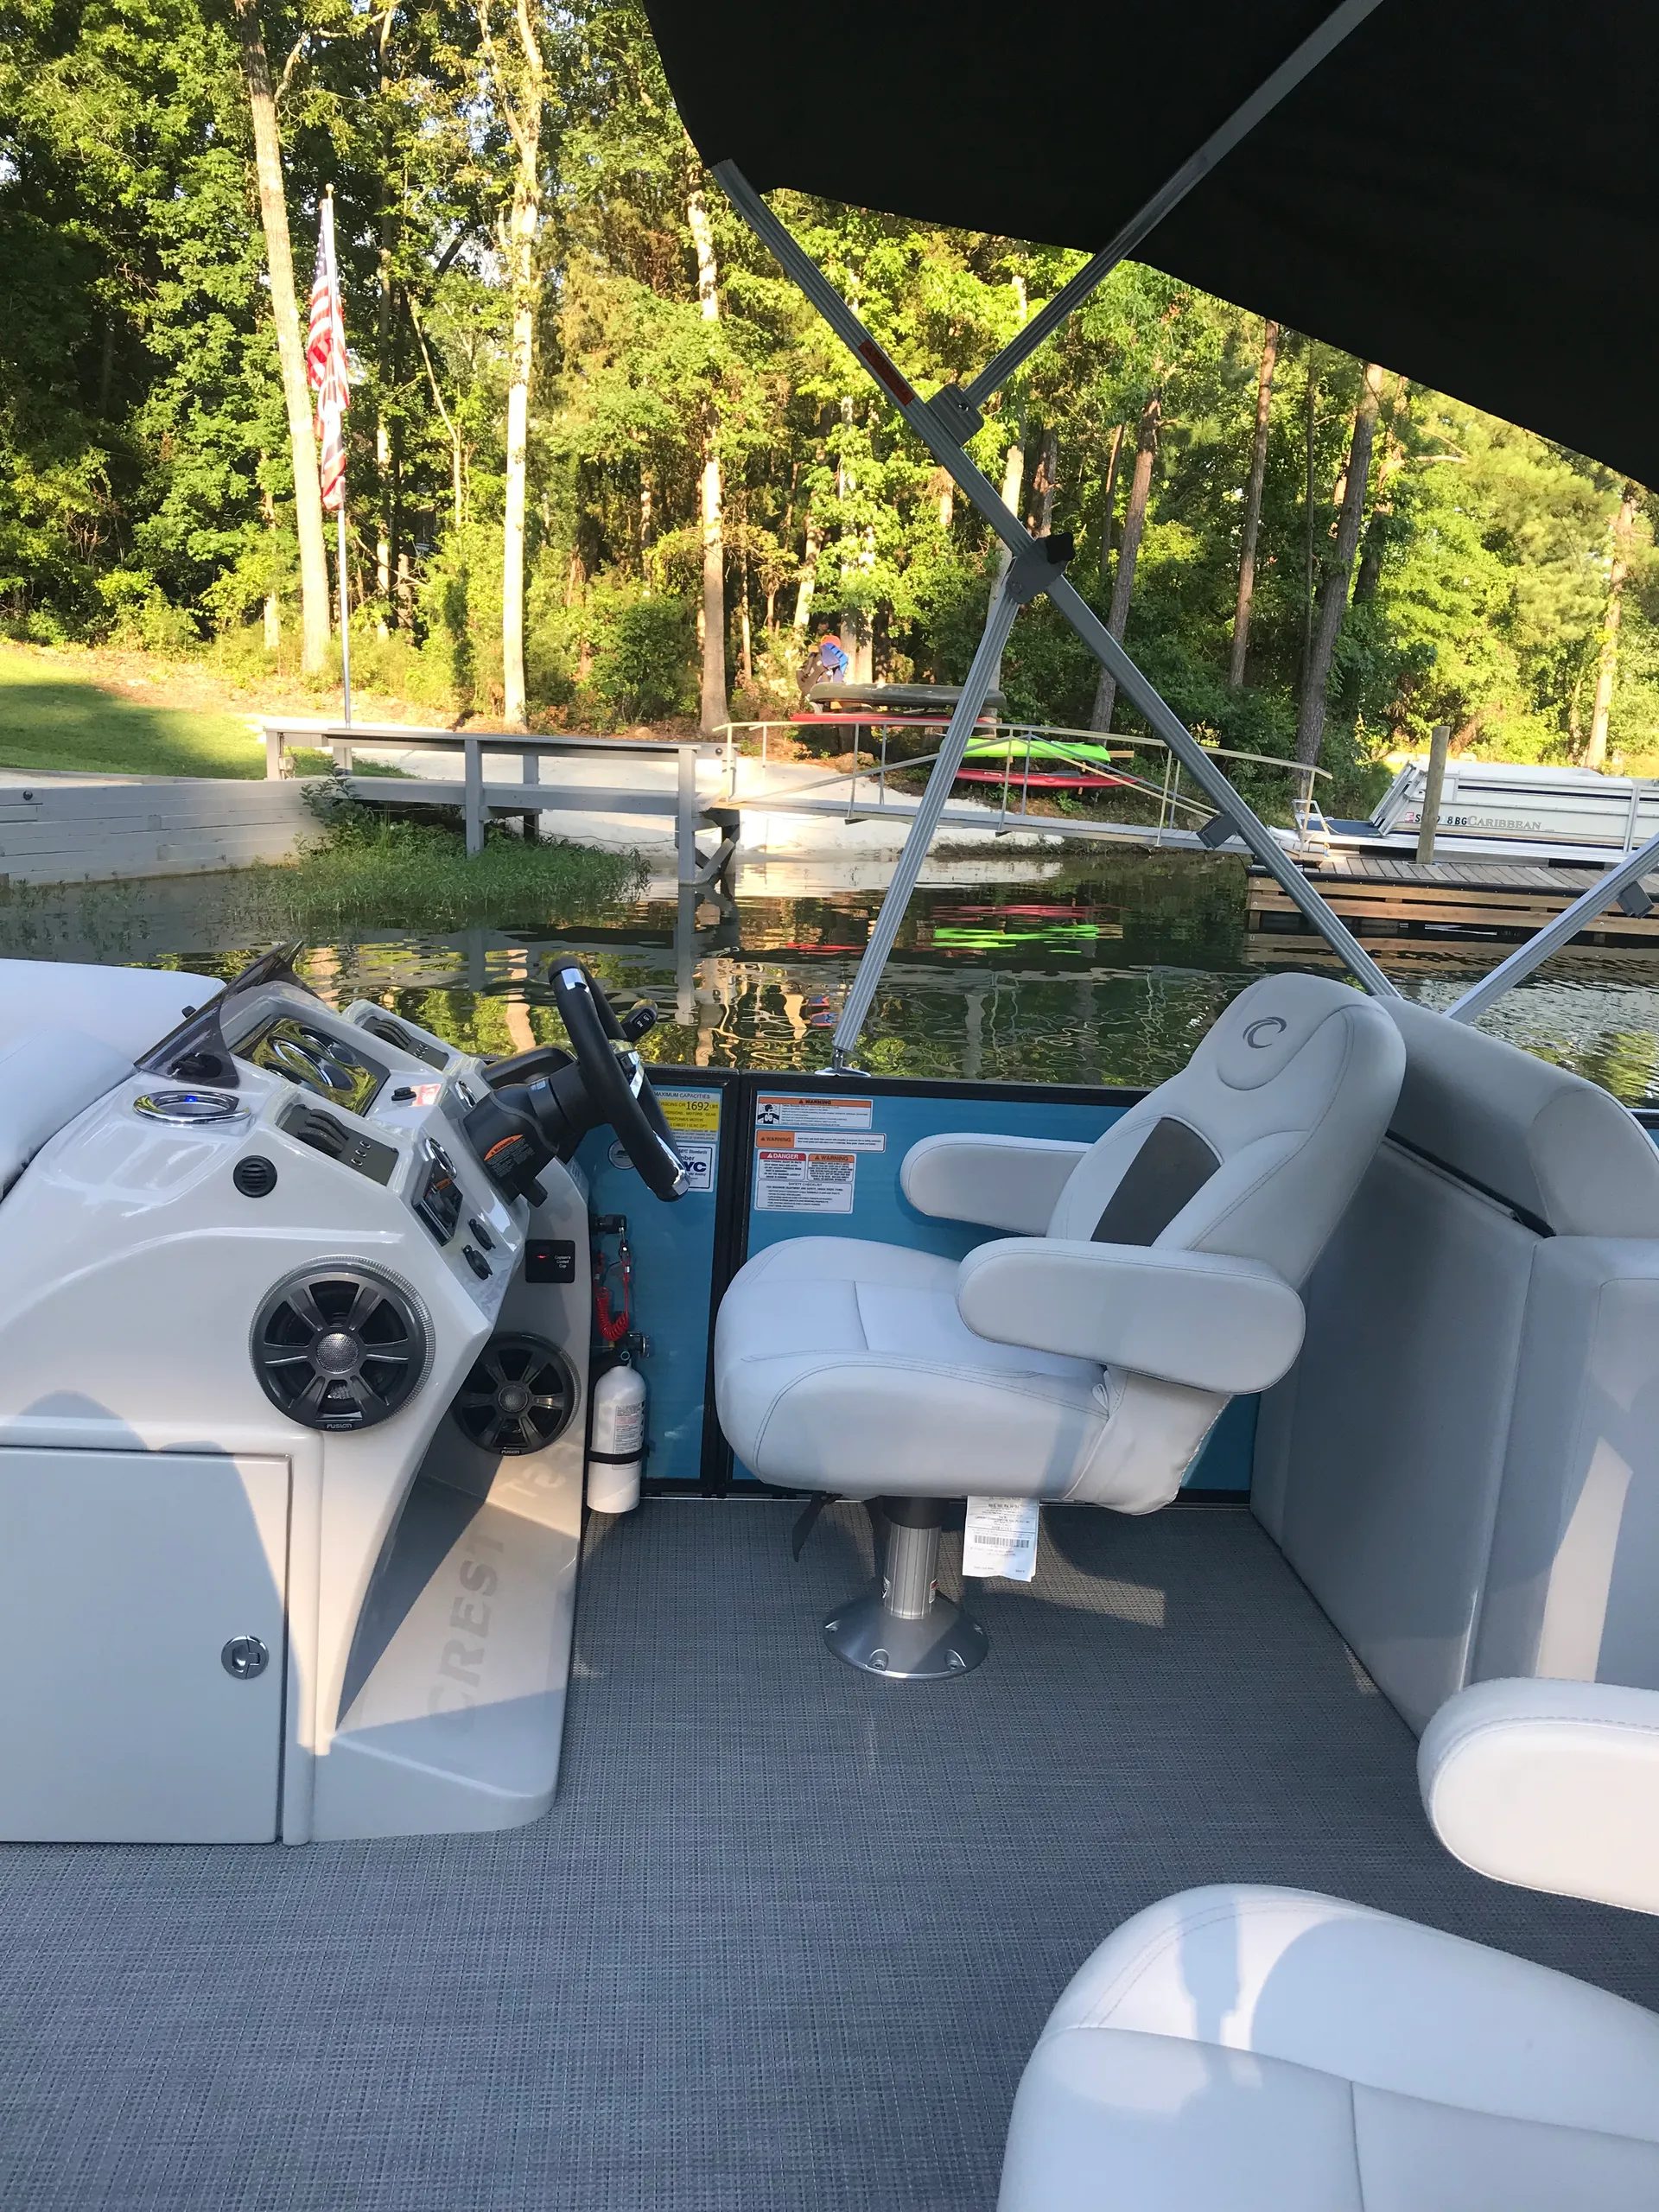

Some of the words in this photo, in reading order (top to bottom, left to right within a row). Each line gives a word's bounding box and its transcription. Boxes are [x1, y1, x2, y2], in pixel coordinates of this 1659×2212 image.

[1468, 816, 1541, 830] CARIBBEAN
[685, 1101, 709, 1111] 1692
[427, 1514, 504, 1732] CREST
